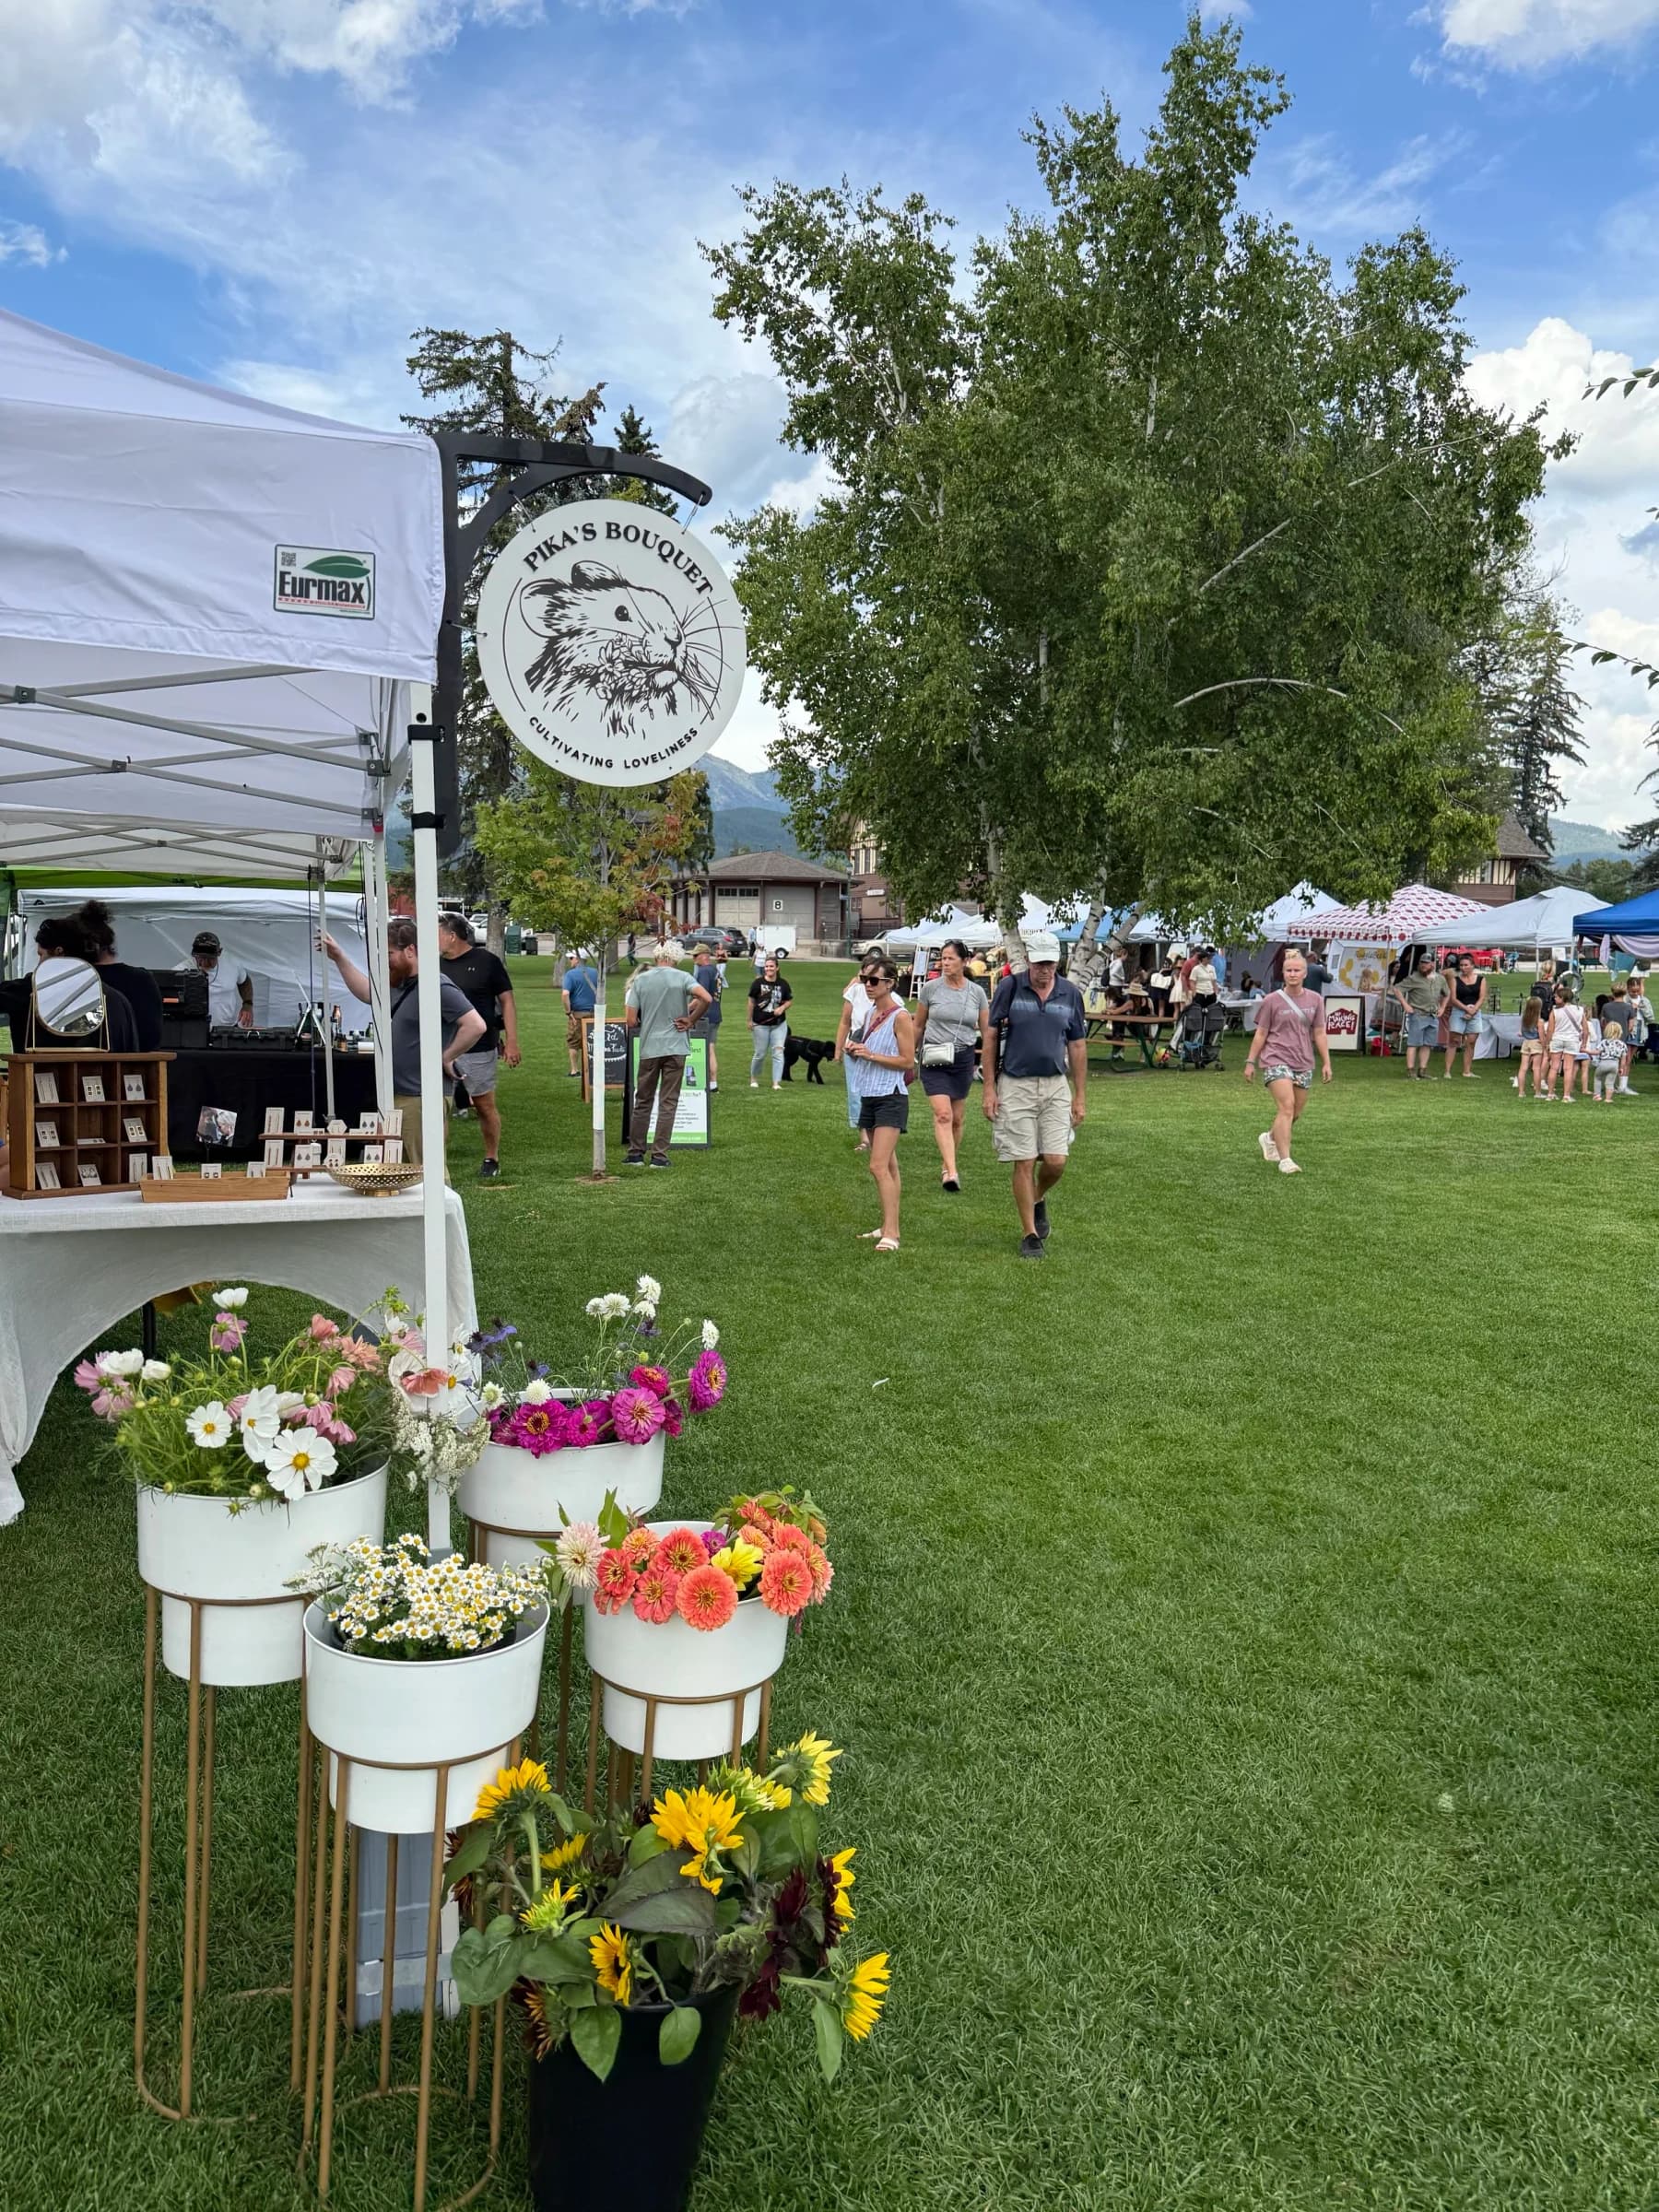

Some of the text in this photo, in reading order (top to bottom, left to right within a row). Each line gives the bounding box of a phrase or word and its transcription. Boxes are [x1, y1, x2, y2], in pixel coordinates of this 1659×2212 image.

[523, 522, 714, 595] PIKA'S BOUQUET
[278, 570, 365, 605] Eurmax
[529, 716, 699, 770] CULTIVATING LOVELINESS
[774, 900, 782, 910] 8
